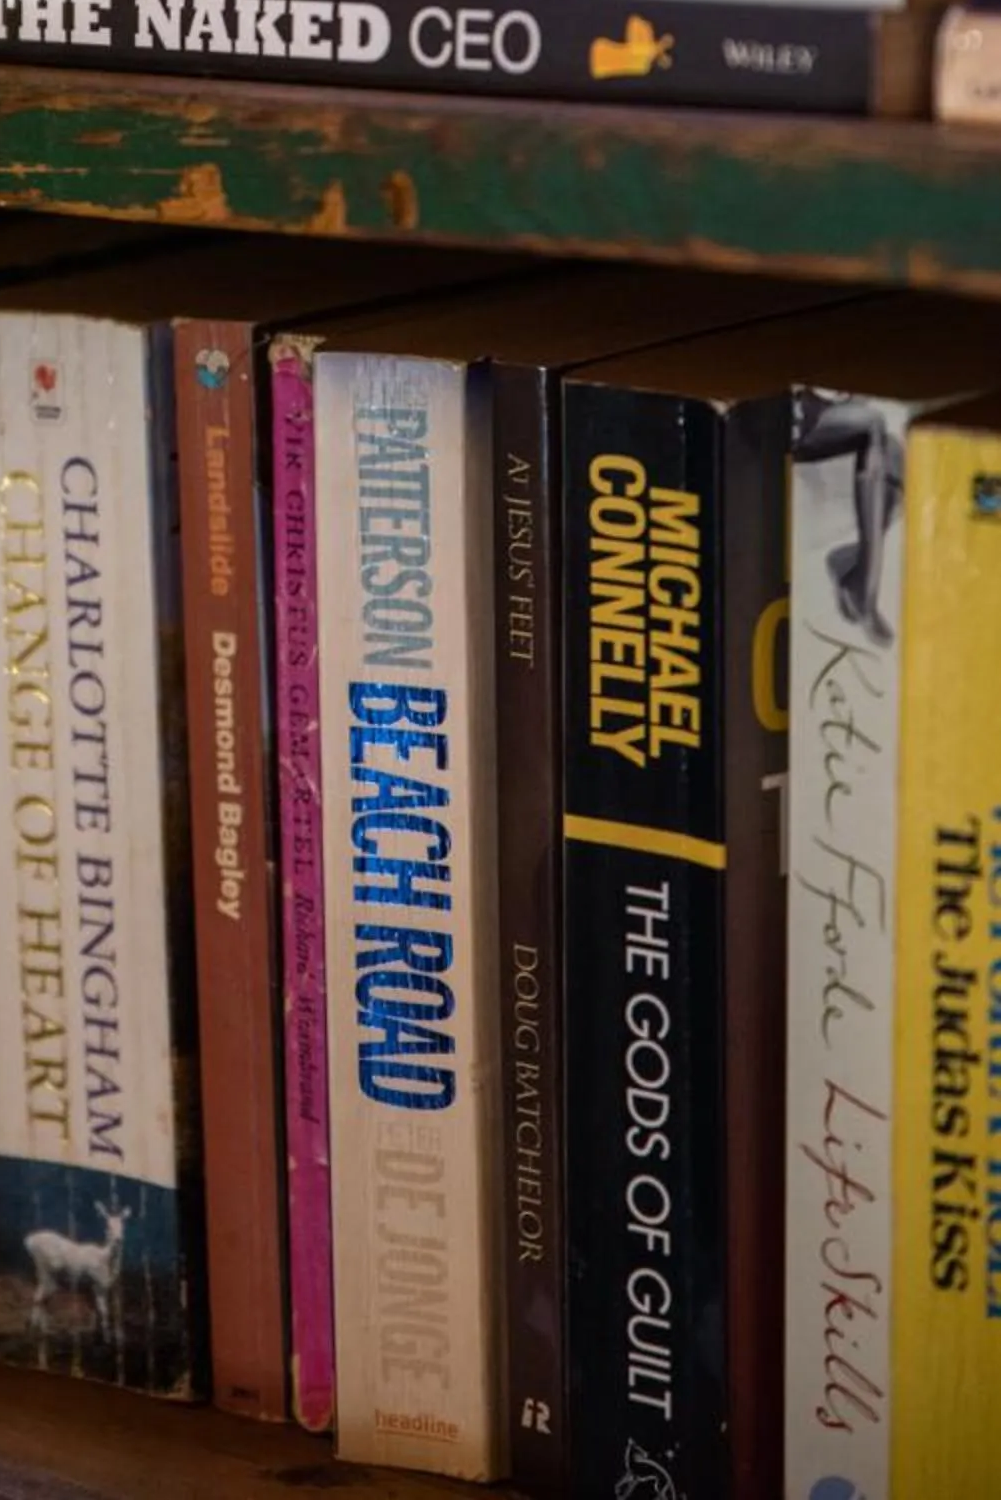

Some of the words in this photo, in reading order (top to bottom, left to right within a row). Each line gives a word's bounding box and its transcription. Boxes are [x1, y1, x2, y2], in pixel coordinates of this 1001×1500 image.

[409, 6, 542, 75] CEO
[722, 37, 818, 75] WILEY
[205, 425, 234, 597] Landslide
[283, 412, 305, 471] VIR
[507, 453, 530, 484] AT
[283, 488, 310, 668] CHRISTUS
[356, 407, 434, 670] PATTERSON
[587, 453, 647, 768] CONNELLY
[60, 456, 112, 833] CHARLOTTE
[509, 594, 535, 668] FEET
[648, 487, 701, 759] MICHAEL
[212, 630, 241, 794] Desmond
[348, 681, 452, 911] BEACH
[803, 620, 885, 826] Katie
[11, 794, 59, 886] OF
[214, 800, 244, 921] Bagley
[930, 813, 984, 941] The
[74, 853, 125, 1162] BINGHAM
[512, 941, 540, 1053] DOUG
[624, 880, 670, 980] THE
[794, 836, 888, 1050] Fforde
[16, 906, 70, 1141] HEART
[353, 923, 456, 1112] ROAD
[624, 992, 672, 1160] GODS
[930, 950, 983, 1138] Judas
[376, 1147, 447, 1219] DE
[514, 1060, 544, 1263] BATCHELOR
[625, 1174, 672, 1257] OF
[796, 1077, 890, 1228] Life
[930, 1146, 980, 1292] Kiss
[376, 1222, 451, 1390] JONGE
[626, 1267, 673, 1422] GUILT
[813, 1236, 885, 1434] Skills
[374, 1408, 460, 1438] headline
